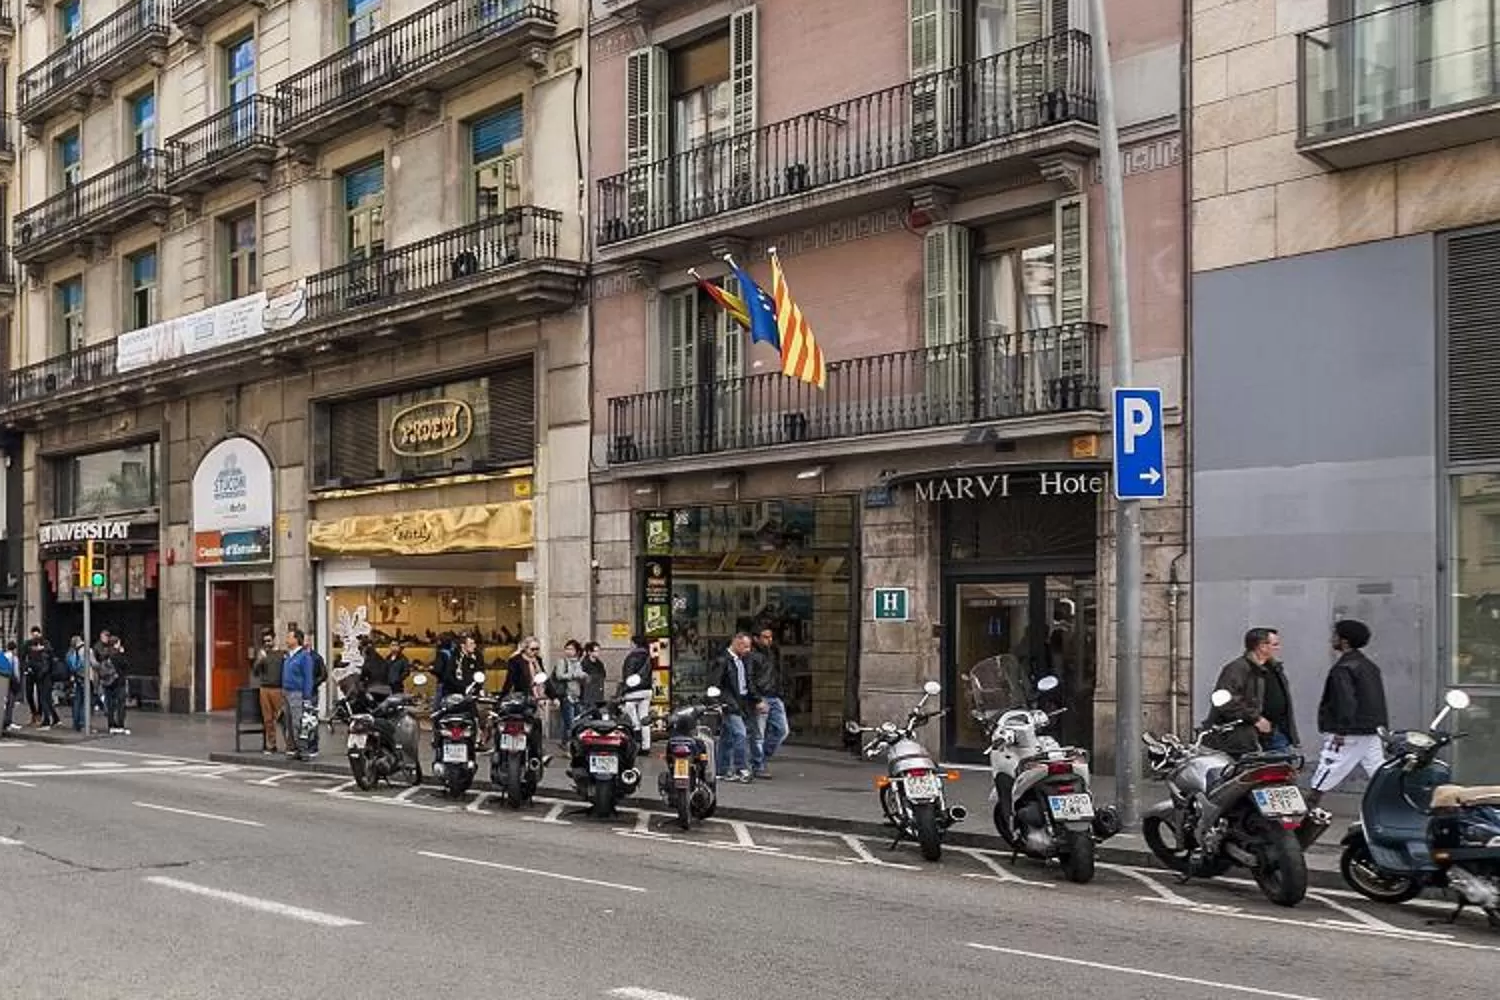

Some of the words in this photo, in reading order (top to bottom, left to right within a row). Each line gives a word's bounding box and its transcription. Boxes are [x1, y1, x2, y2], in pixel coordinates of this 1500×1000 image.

[1123, 397, 1153, 455] P
[915, 474, 1010, 502] MARVI
[1039, 471, 1109, 495] Hotel
[883, 593, 898, 611] H
